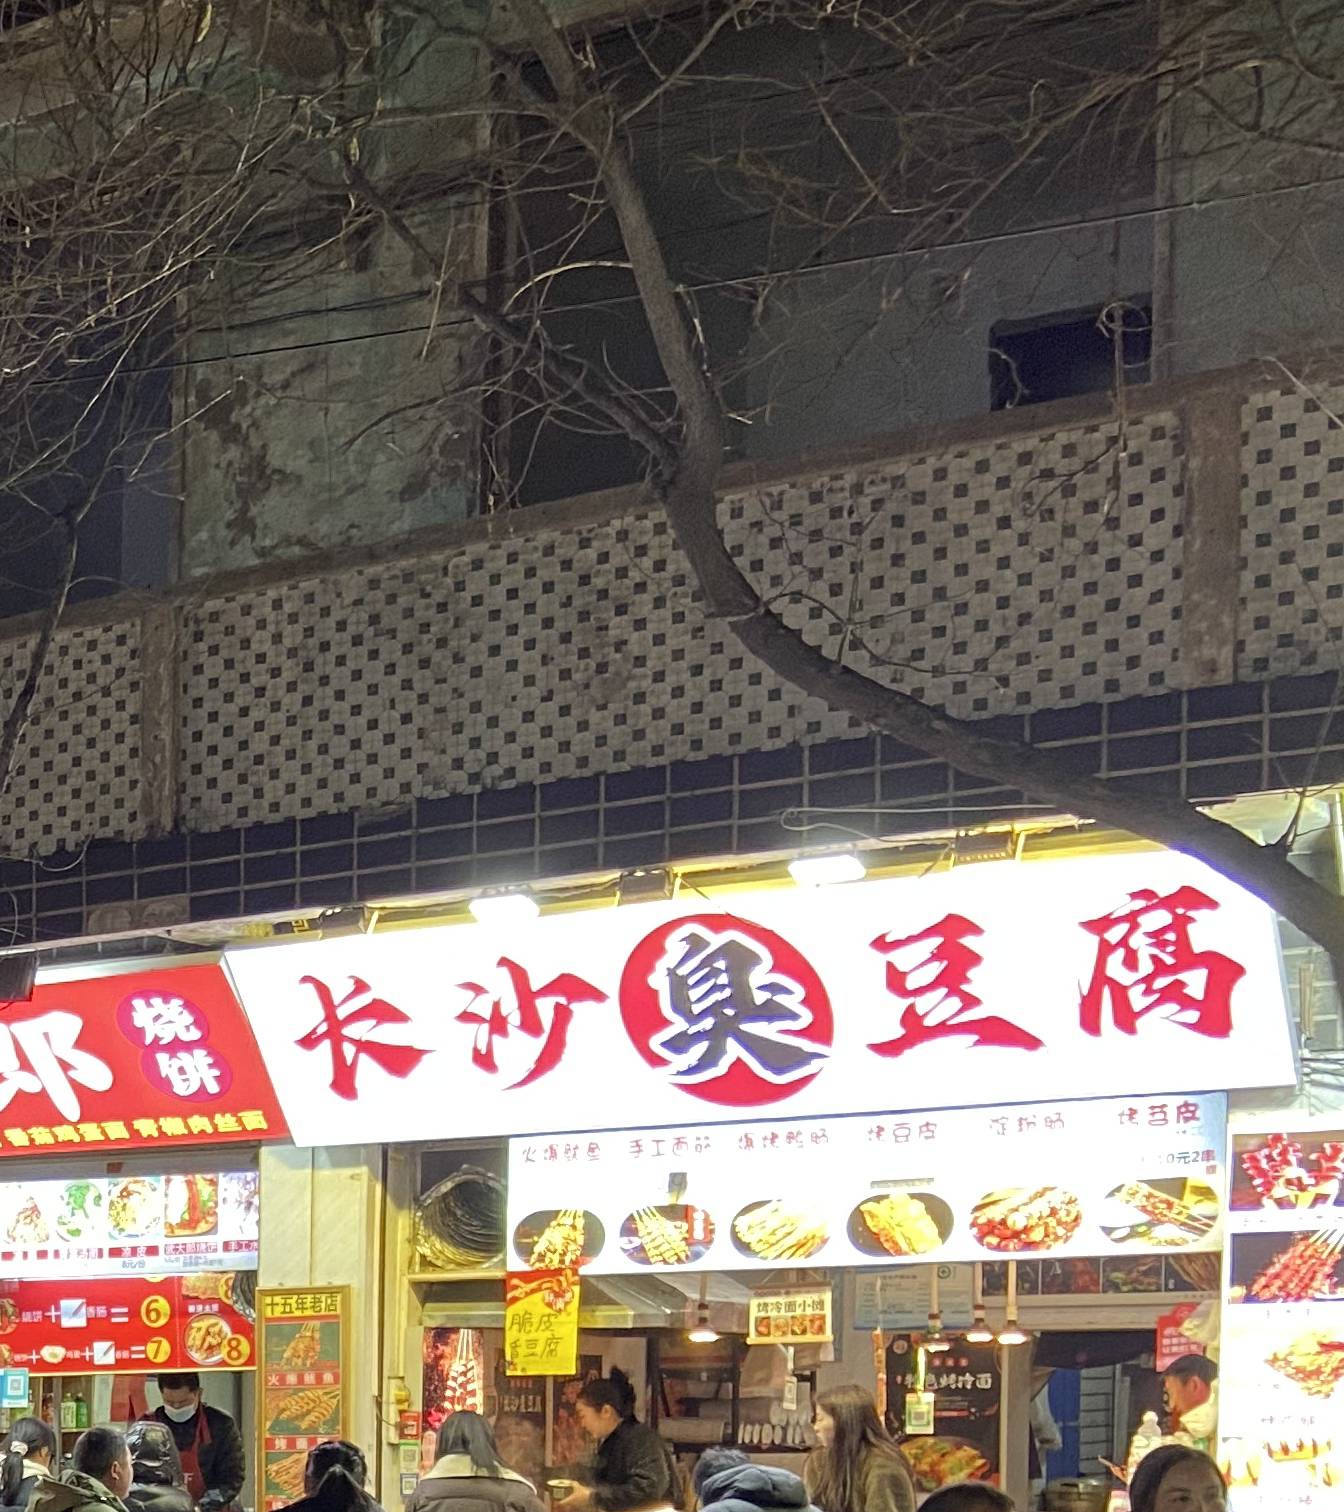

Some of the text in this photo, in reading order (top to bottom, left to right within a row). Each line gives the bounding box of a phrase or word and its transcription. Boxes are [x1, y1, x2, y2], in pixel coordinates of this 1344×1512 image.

[296, 884, 1248, 1101] 长沙臭豆腐
[130, 995, 225, 1098] 烧饼
[144, 1298, 161, 1324] 6
[265, 1293, 339, 1316] 十五年老店
[148, 1338, 163, 1361] 7
[225, 1338, 241, 1361] 8
